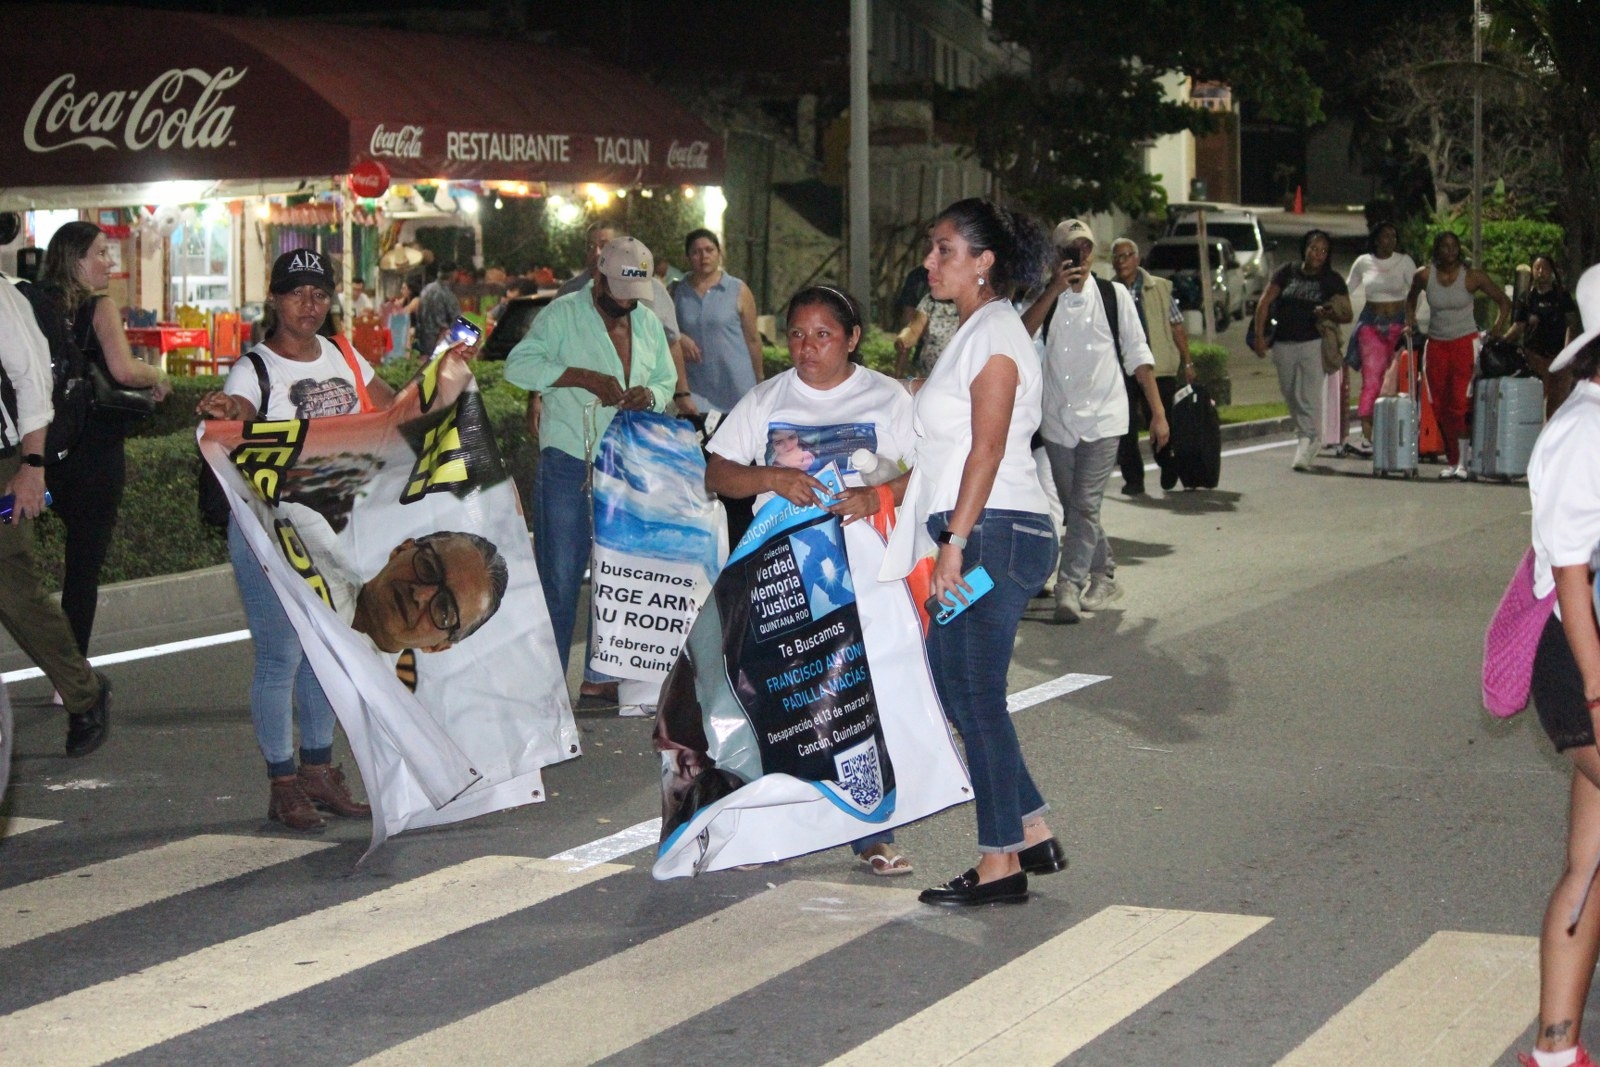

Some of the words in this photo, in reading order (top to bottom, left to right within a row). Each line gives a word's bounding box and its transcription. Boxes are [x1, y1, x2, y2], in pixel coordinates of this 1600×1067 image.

[24, 66, 248, 152] Coca-Cola
[447, 131, 570, 162] RESTAURANTE
[595, 137, 650, 166] TACUN
[756, 553, 796, 583] Verdad
[647, 592, 703, 612] ARM
[750, 573, 801, 604] Memoria
[761, 591, 806, 619] Justicia
[760, 615, 795, 635] QUINTANA
[795, 608, 810, 624] ROO
[609, 635, 665, 655] febrero
[778, 643, 793, 659] Te
[794, 621, 846, 654] Buscamos
[766, 659, 824, 693] FRANCISCO
[782, 683, 828, 712] PADILLA
[827, 665, 867, 693] MACÍAS
[813, 712, 821, 726] el
[821, 707, 832, 721] 13
[832, 704, 843, 719] de
[844, 696, 865, 713] marzo
[832, 720, 867, 744] Quintana
